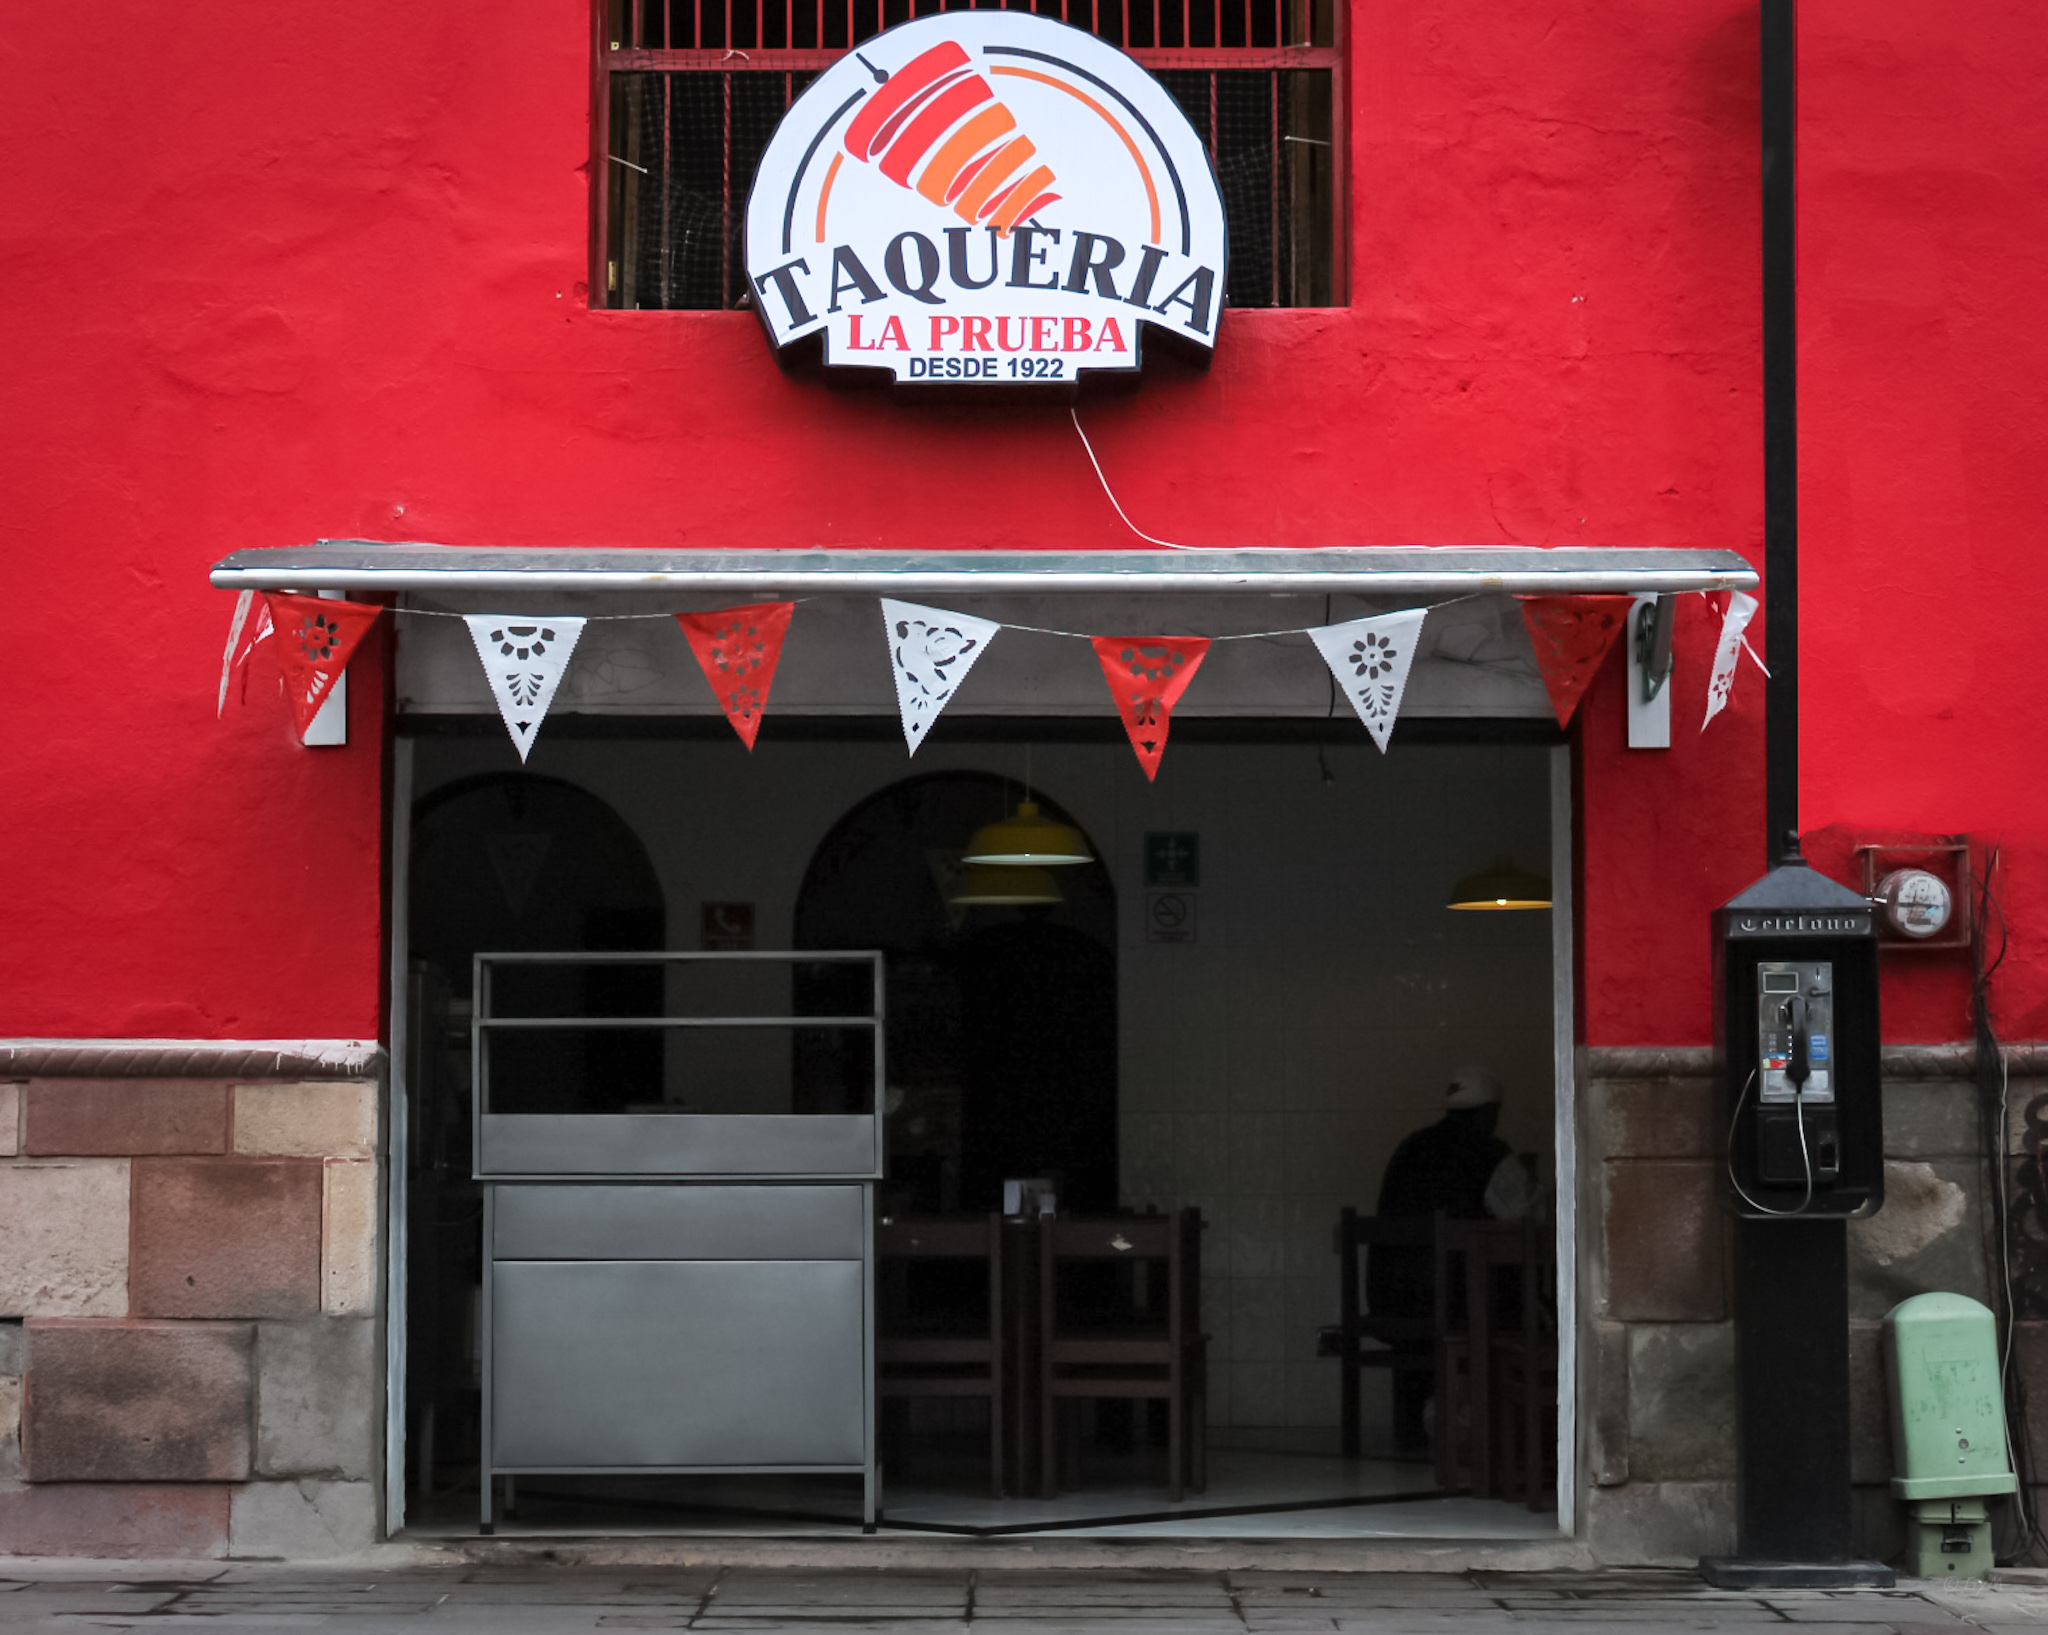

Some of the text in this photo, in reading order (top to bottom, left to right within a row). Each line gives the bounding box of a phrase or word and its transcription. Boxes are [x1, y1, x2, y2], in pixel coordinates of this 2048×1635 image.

[846, 314, 1129, 353] LA PRUEBA
[909, 357, 1064, 379] DESDE 1922
